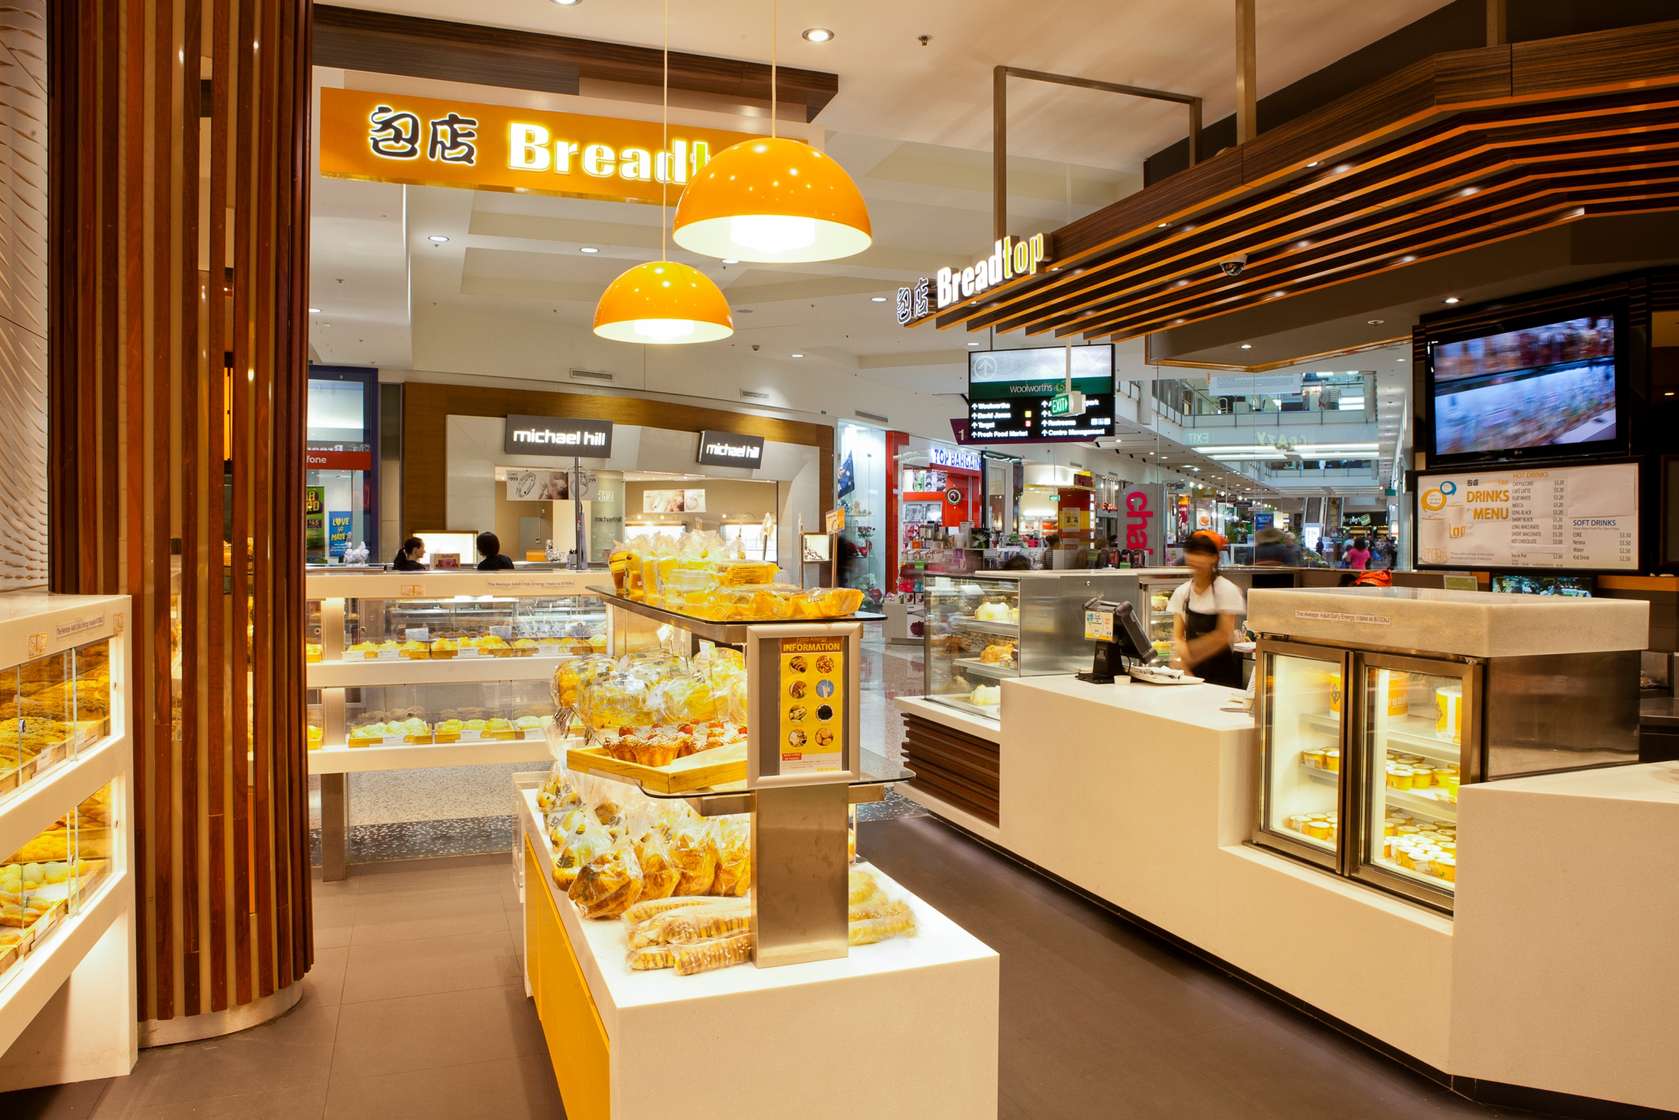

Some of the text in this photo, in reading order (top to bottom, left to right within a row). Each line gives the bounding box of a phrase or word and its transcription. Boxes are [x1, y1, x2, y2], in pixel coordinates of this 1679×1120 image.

[508, 122, 710, 185] Breadt
[937, 233, 1044, 309] Breadtop
[1010, 384, 1053, 393] Woolworths
[1052, 397, 1066, 413] EXIT
[513, 428, 606, 446] michael hill
[958, 429, 965, 440] 1
[706, 442, 760, 459] michael hill
[1466, 489, 1510, 503] DRINKS
[1473, 507, 1510, 520] MENU
[1572, 519, 1617, 527] SOFT DRINKS
[783, 643, 840, 652] INFORMATION
